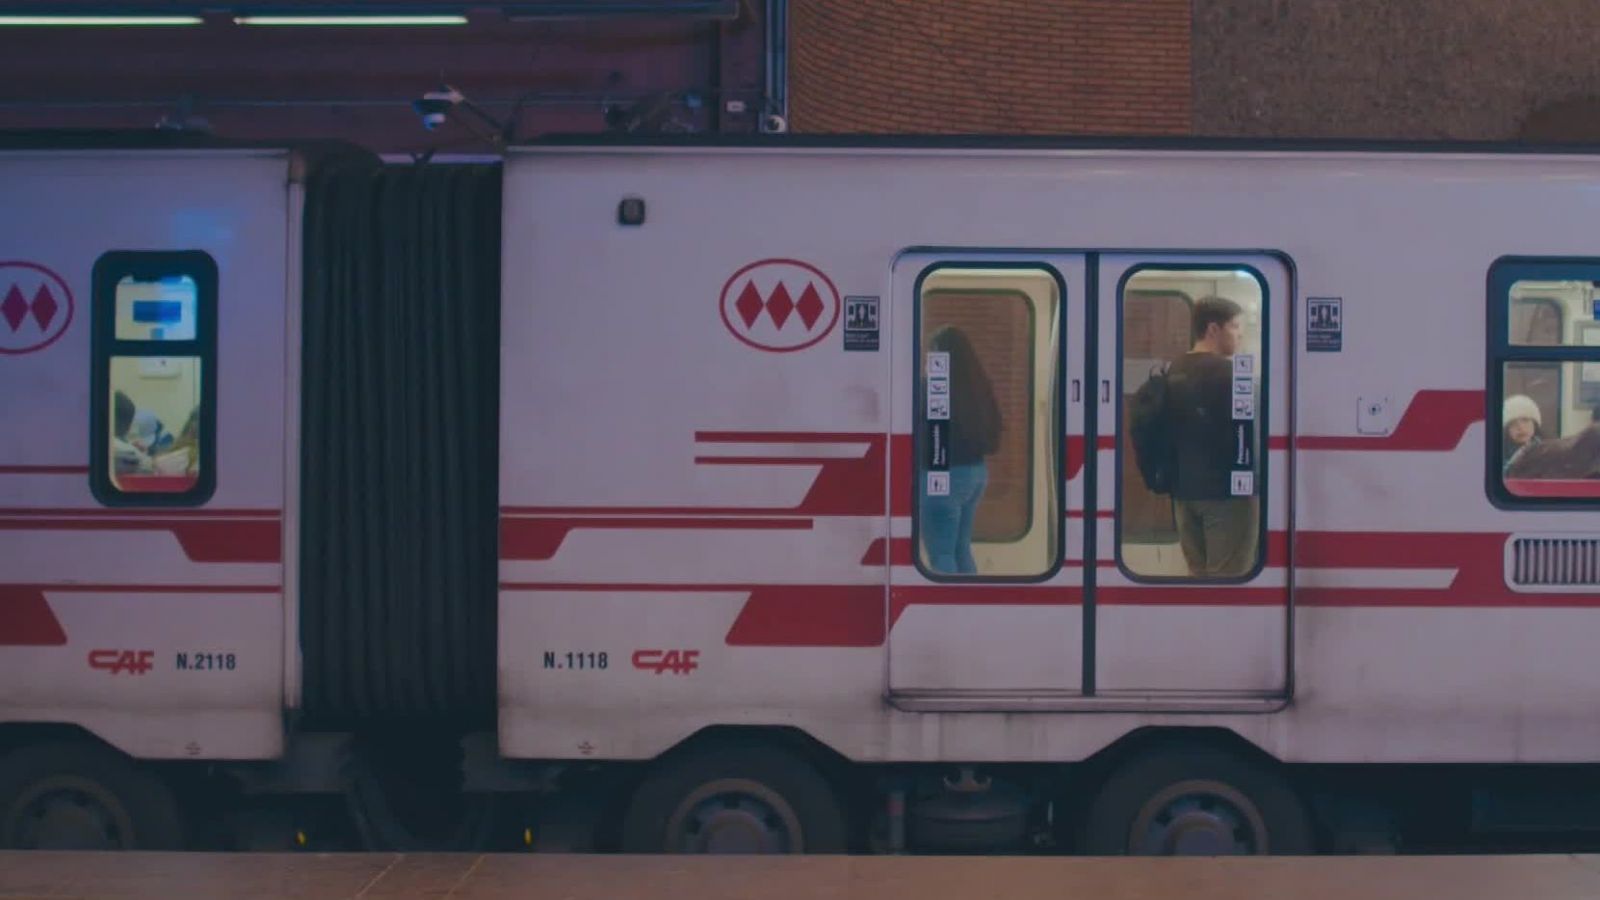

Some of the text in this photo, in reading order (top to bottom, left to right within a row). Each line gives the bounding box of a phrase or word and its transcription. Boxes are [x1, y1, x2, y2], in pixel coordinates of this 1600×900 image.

[88, 650, 154, 674] CAF
[176, 652, 236, 670] N.2118
[543, 651, 608, 669] N.1118
[632, 649, 700, 674] CAF
